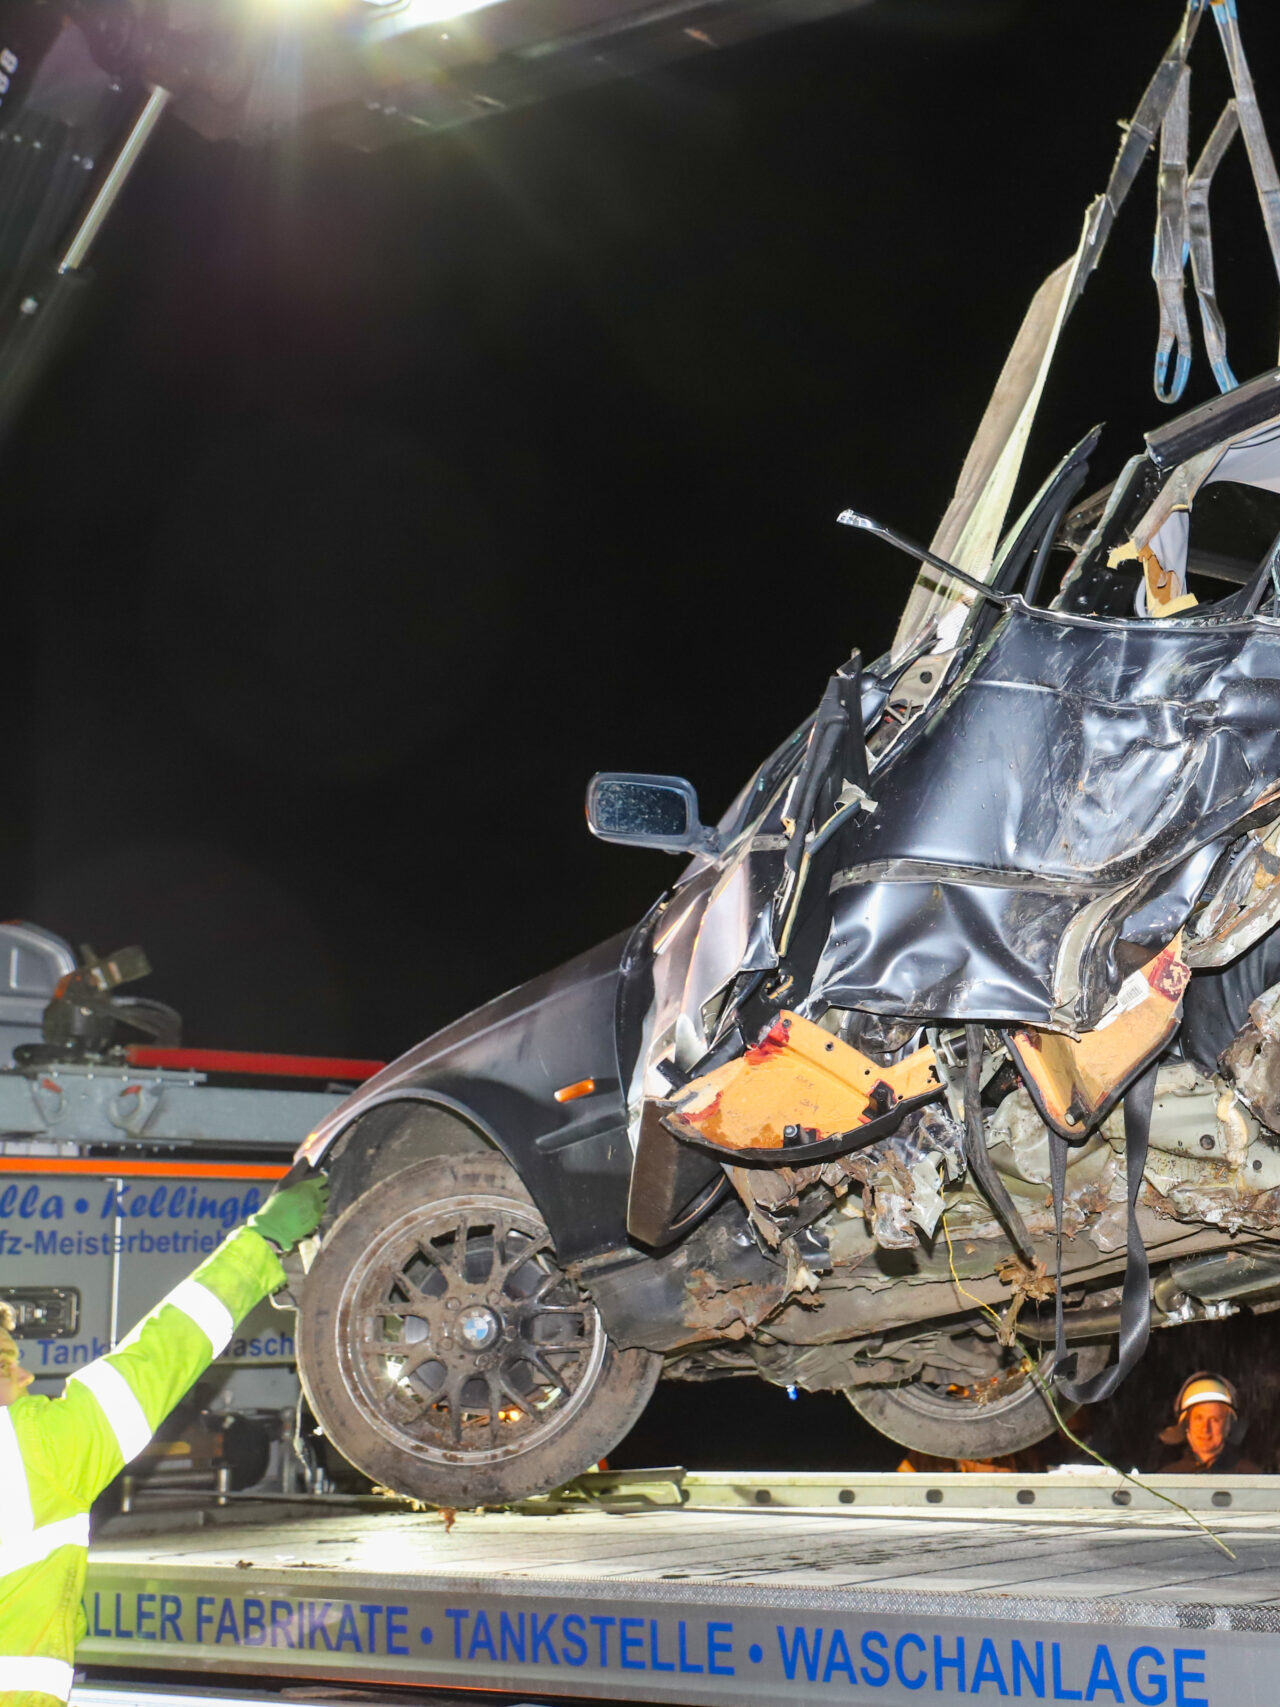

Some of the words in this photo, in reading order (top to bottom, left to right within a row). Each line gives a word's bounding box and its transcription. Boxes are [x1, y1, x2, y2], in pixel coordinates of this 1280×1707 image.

[37, 1337, 118, 1365] Tank
[223, 1331, 295, 1357] asch
[197, 1596, 410, 1655] FABRIKATE
[445, 1607, 737, 1677] TANKSTELLE
[776, 1624, 1210, 1707] WASCHANLAGE
